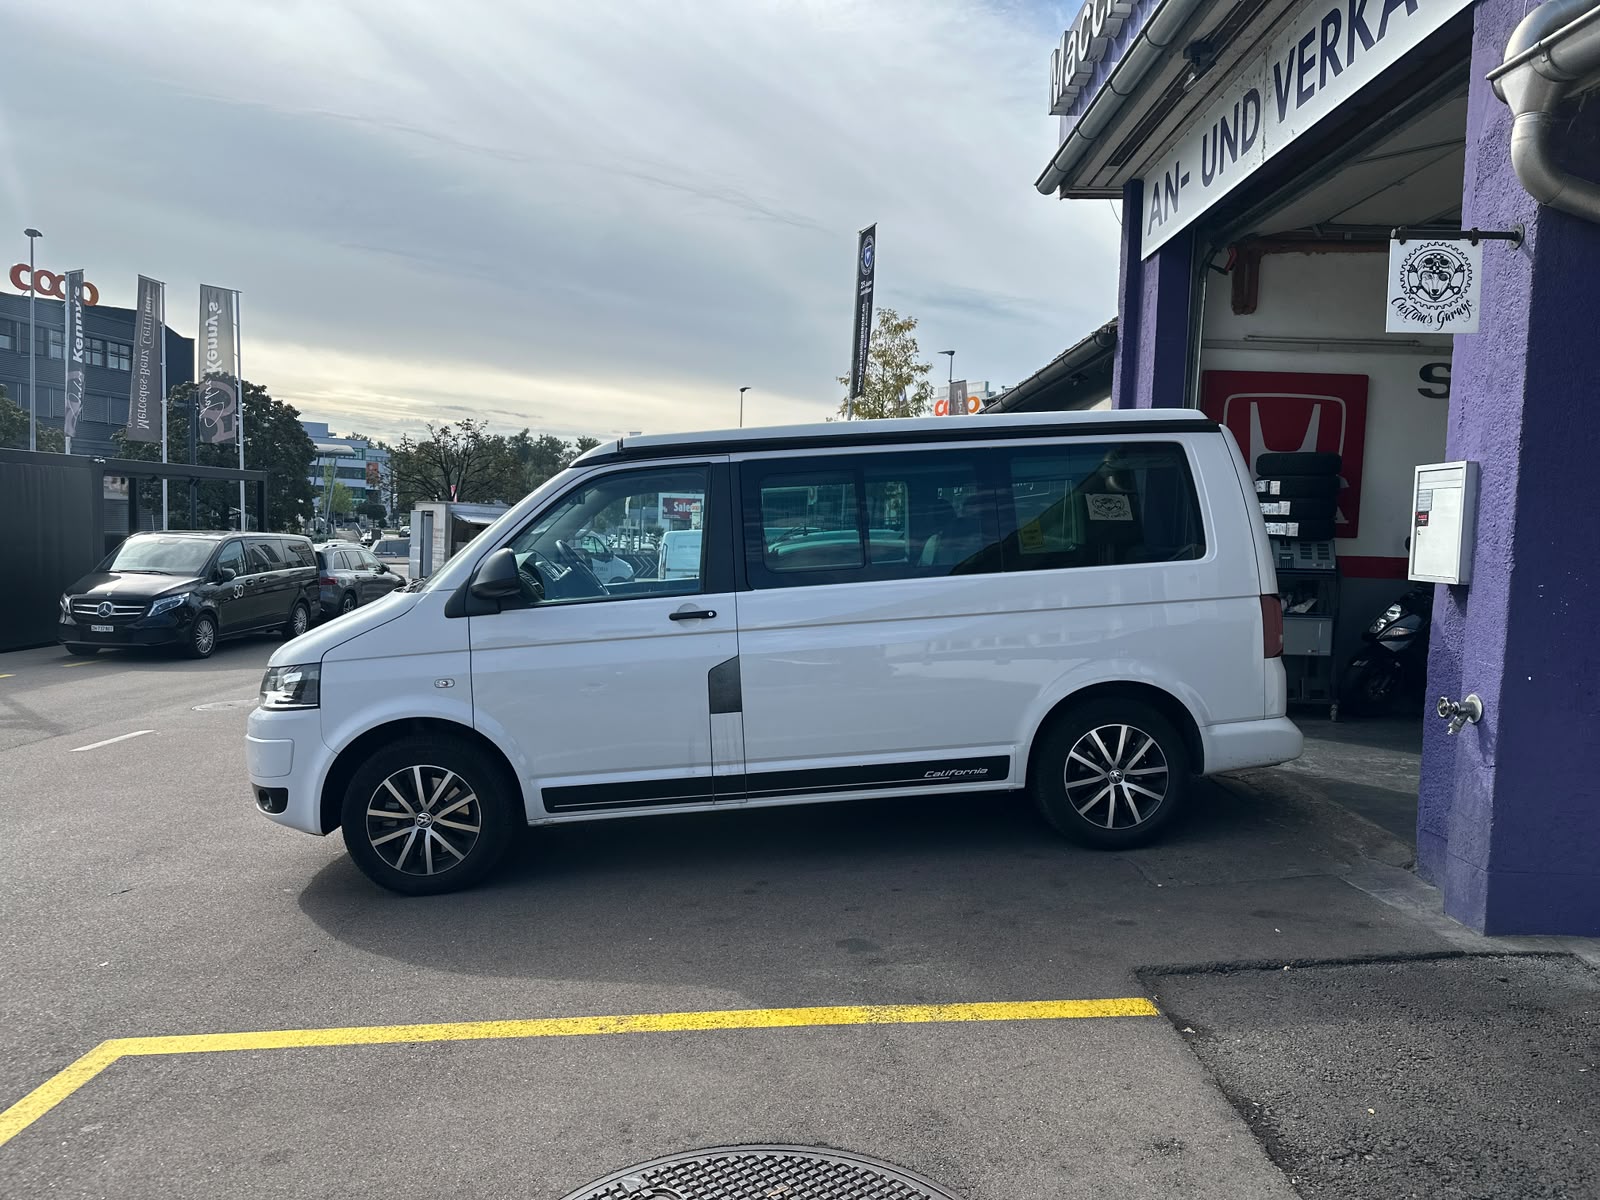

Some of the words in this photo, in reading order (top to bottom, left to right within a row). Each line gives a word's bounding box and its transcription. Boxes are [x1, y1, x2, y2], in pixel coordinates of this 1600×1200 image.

[1147, 160, 1190, 236] AN-
[1201, 87, 1261, 188] UND
[1434, 299, 1474, 331] Garage
[233, 584, 244, 599] 50
[924, 767, 988, 778] California
